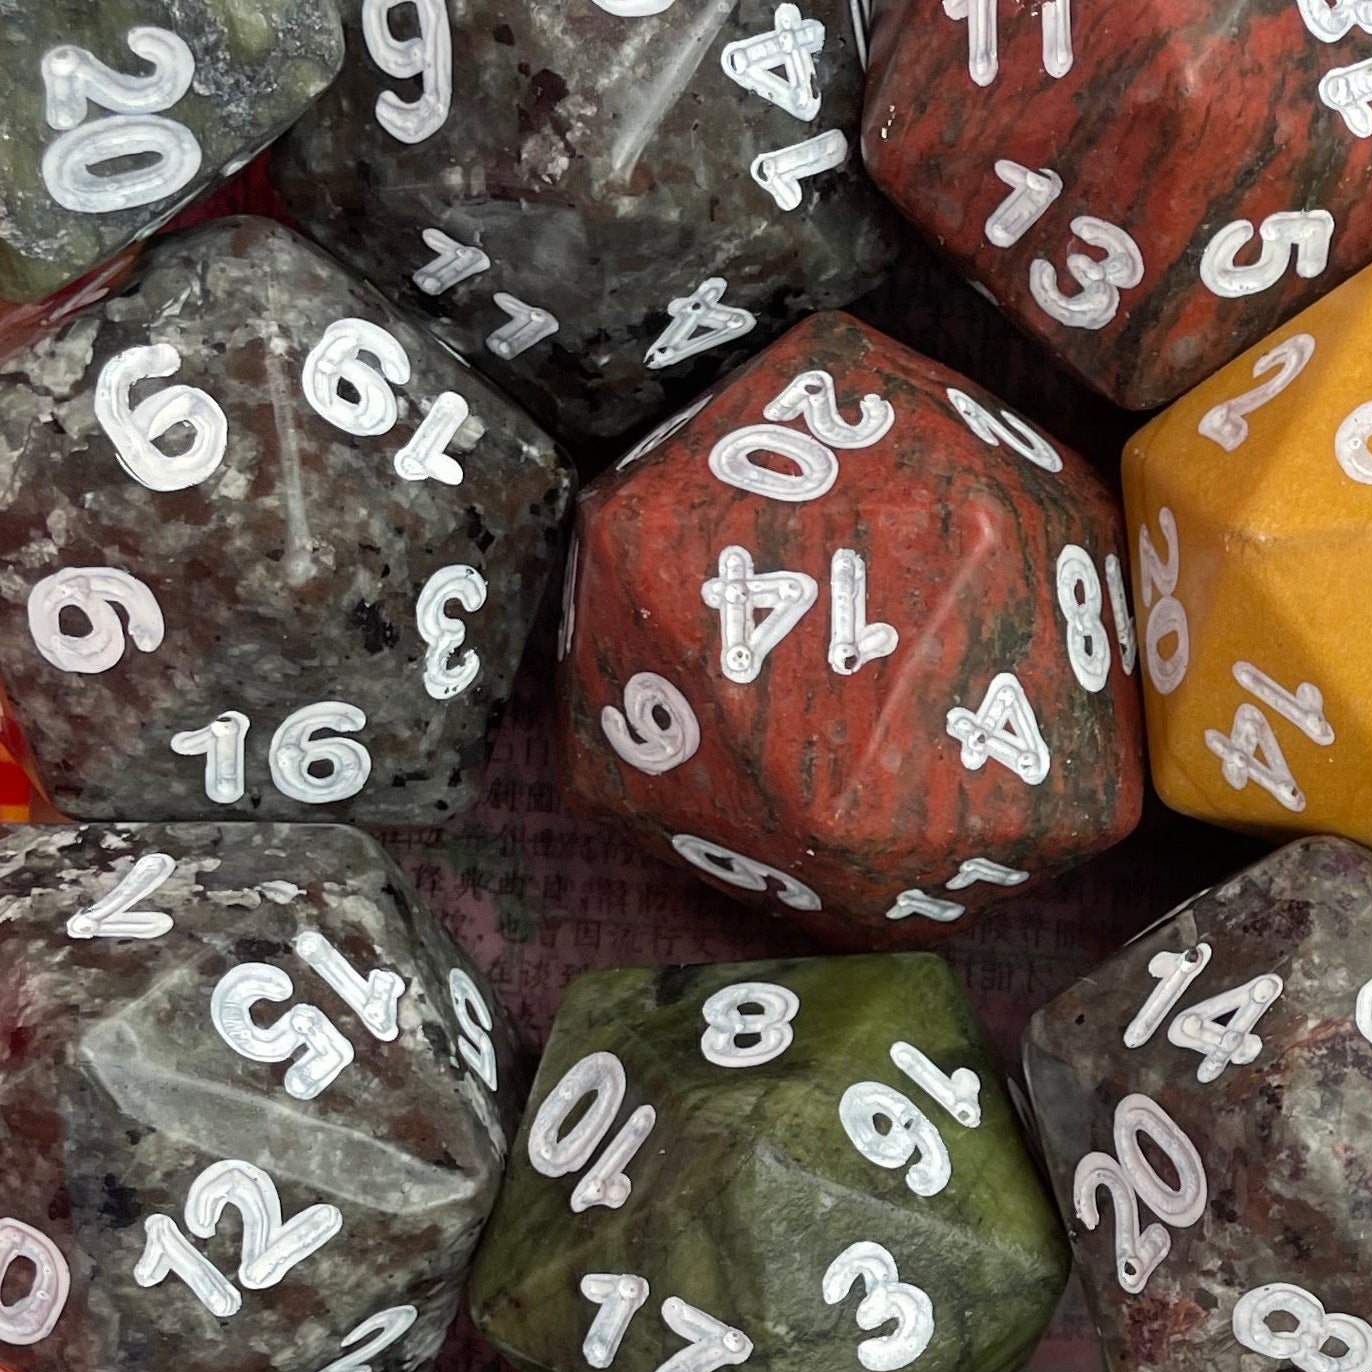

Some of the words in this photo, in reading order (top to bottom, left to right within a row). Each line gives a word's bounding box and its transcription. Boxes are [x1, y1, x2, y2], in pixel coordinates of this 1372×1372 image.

[42, 26, 201, 212] 20
[720, 3, 848, 211] 14
[984, 159, 1145, 330] 13
[1200, 209, 1334, 298] 5
[643, 277, 757, 369] 4
[1198, 333, 1315, 451] 2
[708, 370, 895, 501] 20
[415, 564, 487, 700] 3
[702, 545, 899, 684] 14
[1139, 506, 1189, 695] 20
[171, 700, 372, 803] 16
[946, 673, 1050, 785] 4
[1204, 660, 1335, 812] 14
[210, 931, 406, 1100] 15
[700, 982, 800, 1068] 8
[1123, 943, 1283, 1083] 14
[528, 1051, 656, 1212] 10
[839, 1041, 981, 1196] 16
[134, 1158, 343, 1318] 12
[1073, 1093, 1207, 1293] 20
[822, 1241, 934, 1371] 3
